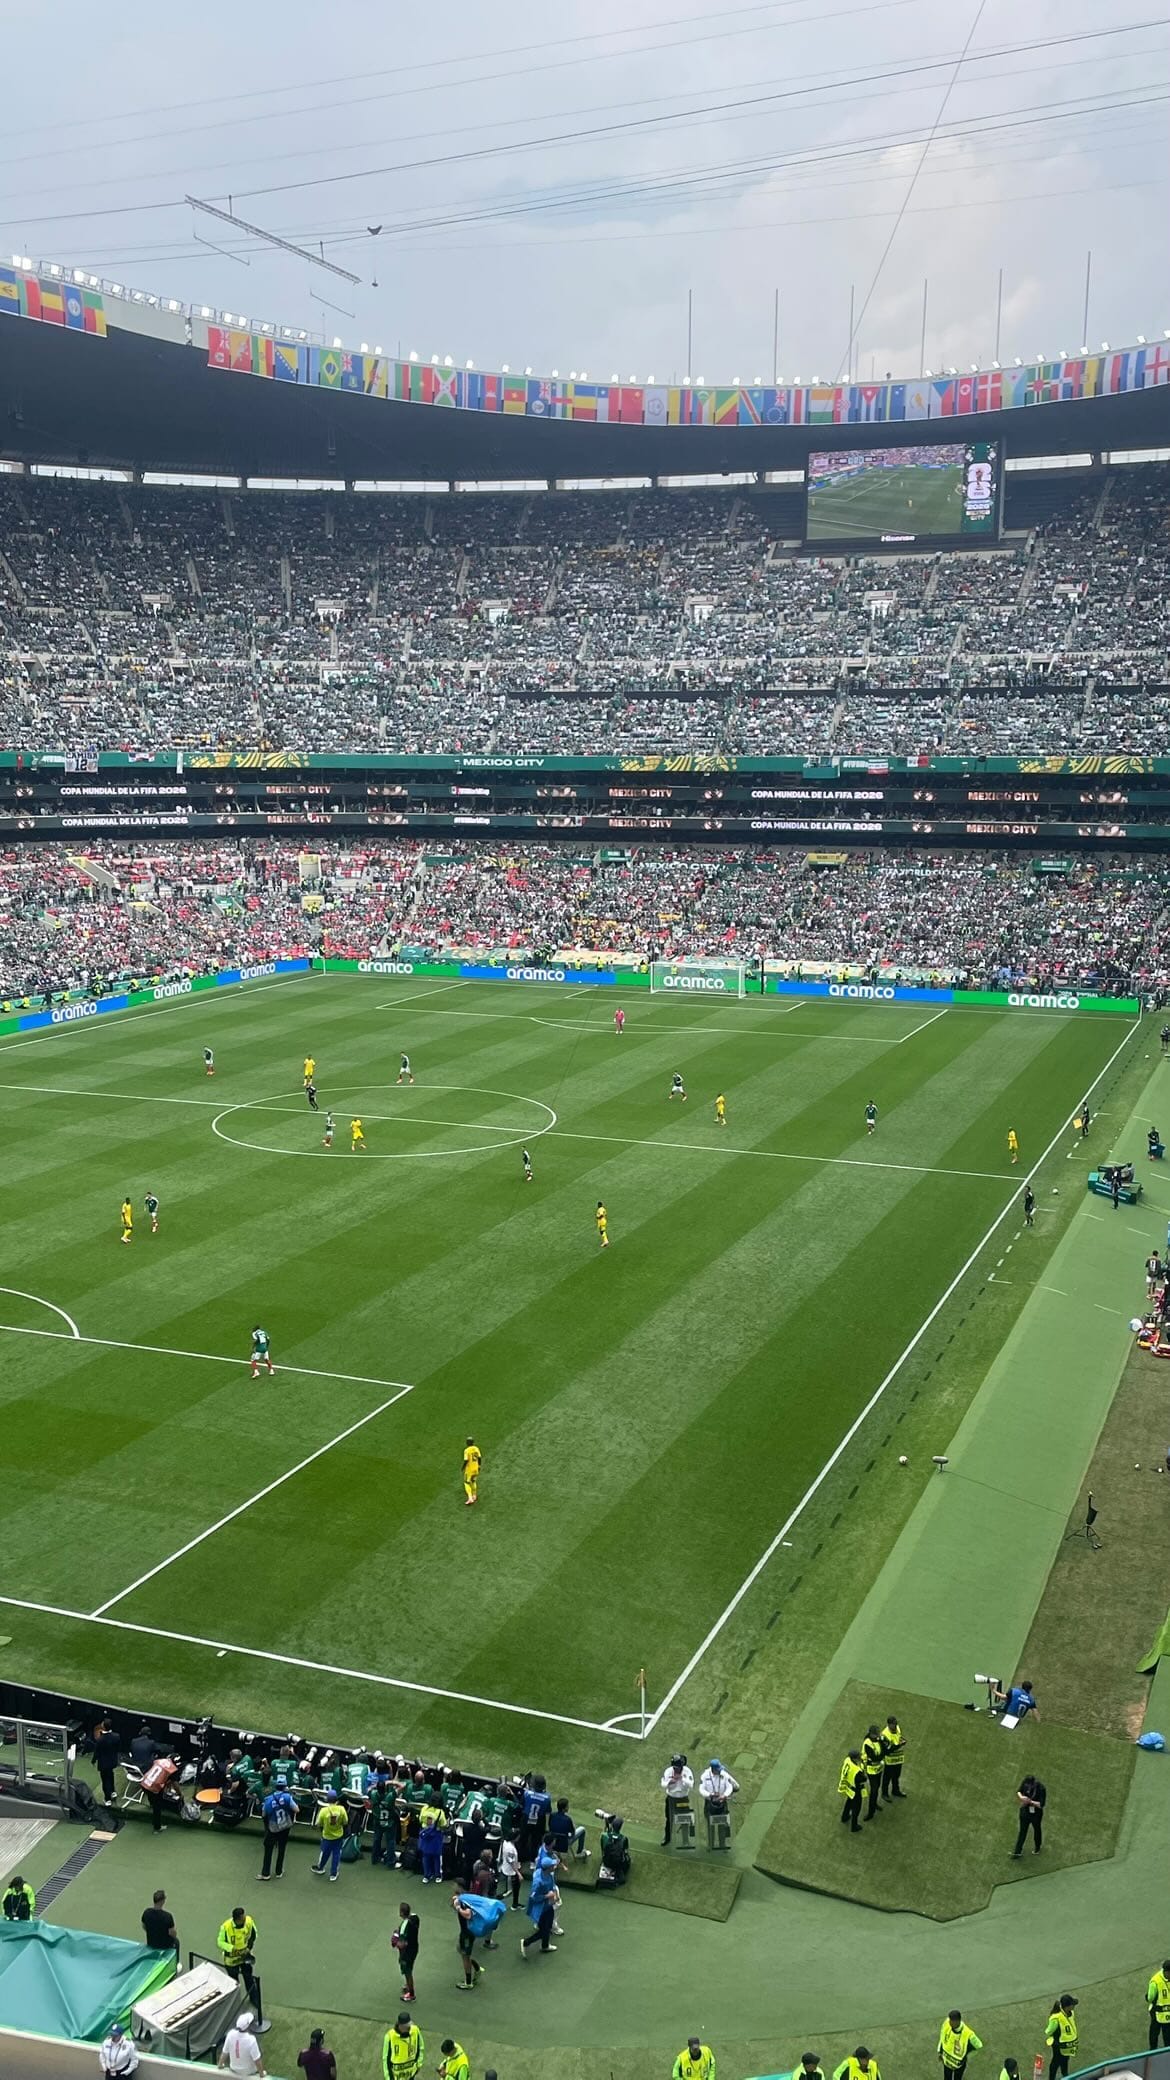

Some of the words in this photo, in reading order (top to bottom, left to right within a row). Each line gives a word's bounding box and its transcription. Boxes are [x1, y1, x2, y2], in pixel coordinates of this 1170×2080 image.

[75, 759, 87, 770] 12
[83, 787, 117, 795] MUNDIAL
[609, 788, 647, 797] MEXICO
[650, 789, 672, 798] CITY
[968, 792, 1012, 801] MEXICO
[1014, 792, 1040, 801] CITY
[84, 818, 118, 826] MUNDIAL
[609, 819, 647, 828] MEXICO
[650, 819, 672, 828] CITY
[966, 824, 1010, 833] MEXICO
[1012, 825, 1039, 834] CITY
[240, 963, 276, 980] aramco
[358, 961, 413, 974] aramco
[506, 967, 565, 981] aramco
[663, 976, 724, 990] aramco
[154, 980, 192, 1000] aramco
[829, 984, 894, 999] aramco
[1008, 993, 1079, 1009] aramco
[52, 1001, 97, 1023] aramco
